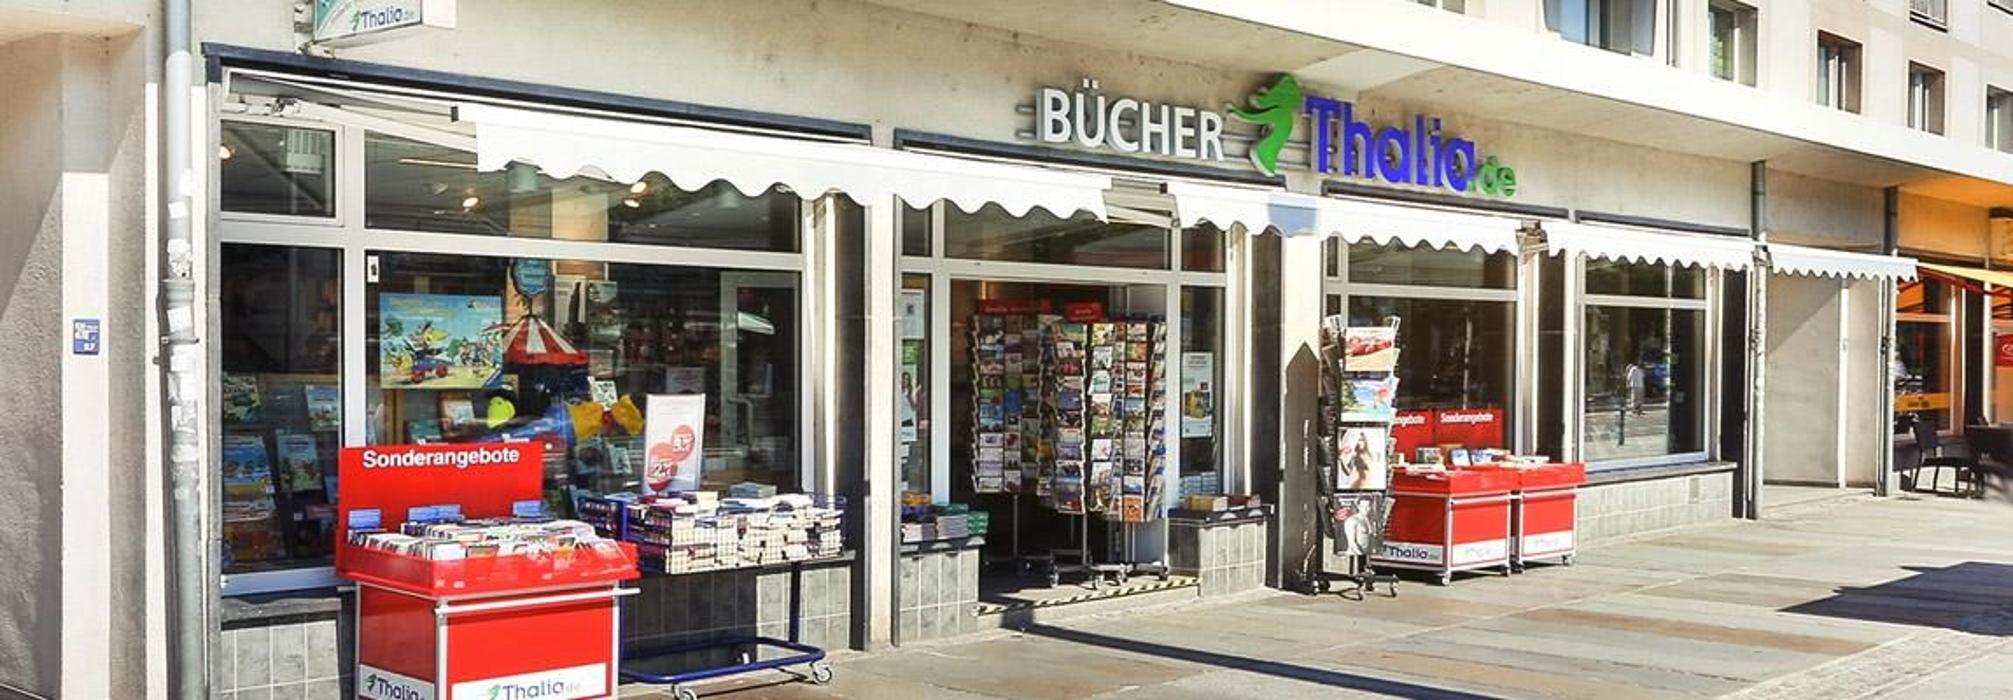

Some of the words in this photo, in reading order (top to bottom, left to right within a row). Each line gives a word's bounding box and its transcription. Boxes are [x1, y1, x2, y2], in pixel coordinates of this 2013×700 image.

[1038, 78, 1224, 162] BÜCHER
[1305, 95, 1517, 197] Thalia.de
[1441, 412, 1494, 424] Sonderangebote
[363, 448, 520, 468] Sonderangebote
